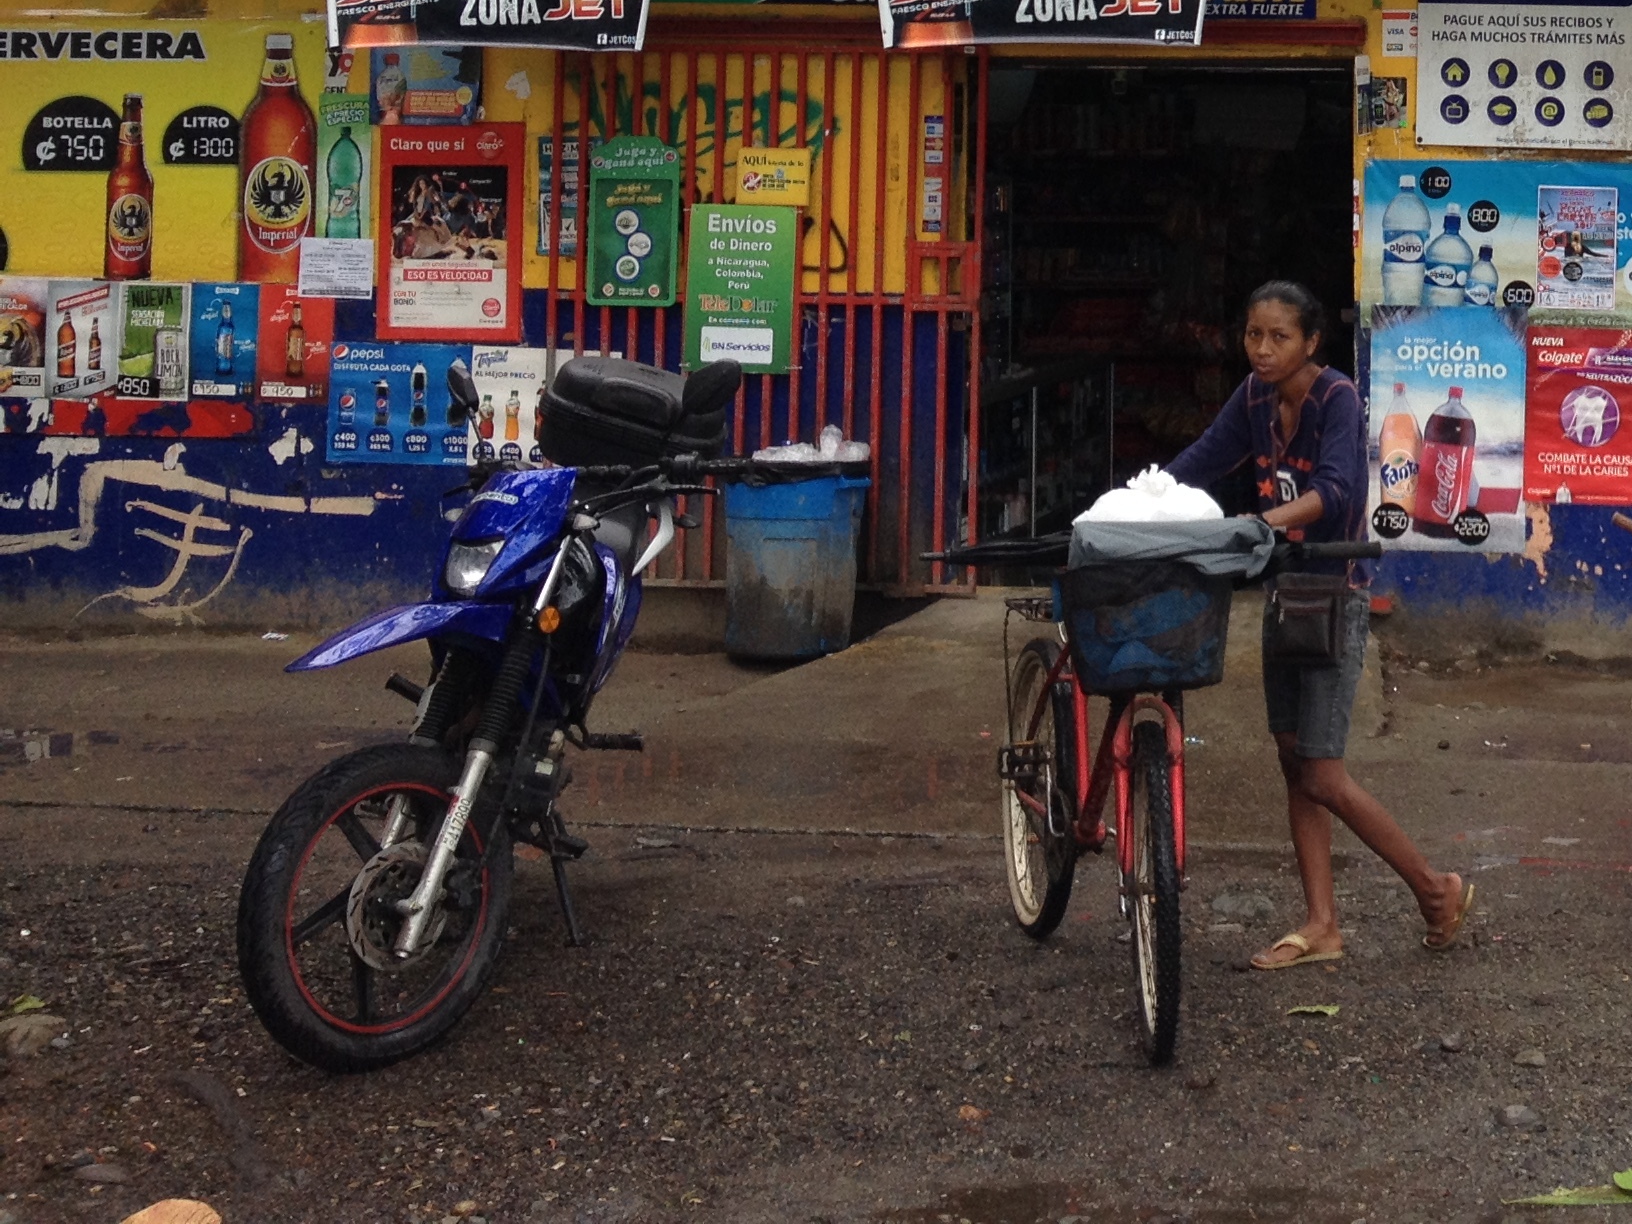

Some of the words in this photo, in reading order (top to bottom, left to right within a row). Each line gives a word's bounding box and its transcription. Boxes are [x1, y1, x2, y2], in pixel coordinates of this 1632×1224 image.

[337, 6, 376, 17] FRESCO
[891, 3, 930, 16] FRESCO
[1204, 4, 1247, 16] EXTRA
[1251, 4, 1304, 16] FUERTE
[1443, 14, 1484, 26] PAGUE
[1487, 12, 1520, 28] AQUÍ
[1523, 15, 1547, 27] SUS
[1550, 16, 1603, 28] RECIBOS
[1606, 17, 1614, 28] Y
[1431, 30, 1467, 42] HAGA
[1470, 31, 1526, 44] MUCHOS
[1529, 28, 1593, 45] TRÁMITES
[1596, 29, 1625, 46] MÁS
[42, 116, 112, 129] BOTELLA
[183, 116, 230, 128] LITRO
[390, 139, 423, 151] Claro
[427, 141, 450, 154] que
[453, 138, 465, 151] sí
[743, 153, 767, 166] AQUÍ
[708, 214, 777, 235] Envíos
[258, 226, 298, 247] Imperial
[709, 239, 727, 250] de
[729, 239, 773, 252] Dinero
[1389, 241, 1423, 255] alpina
[716, 257, 770, 268] Nicaragua,
[407, 270, 426, 281] ESO
[427, 270, 439, 281] ES
[715, 268, 764, 280] Colombia,
[712, 342, 725, 350] BN
[727, 342, 771, 352] Servicios
[1532, 337, 1564, 346] NUEVA
[350, 348, 384, 360] pepsi
[1397, 340, 1480, 363] opción
[1538, 350, 1583, 366] Colgate
[333, 362, 368, 371] DISFRUTA
[369, 363, 390, 372] CADA
[391, 364, 411, 372] GOTA
[1426, 362, 1507, 379] verano
[510, 372, 536, 380] PRECIO
[1538, 452, 1587, 464] COMBATE
[1589, 453, 1602, 464] LA
[1380, 460, 1420, 490] Fanta
[1563, 464, 1577, 475] DE
[1579, 465, 1592, 475] LA
